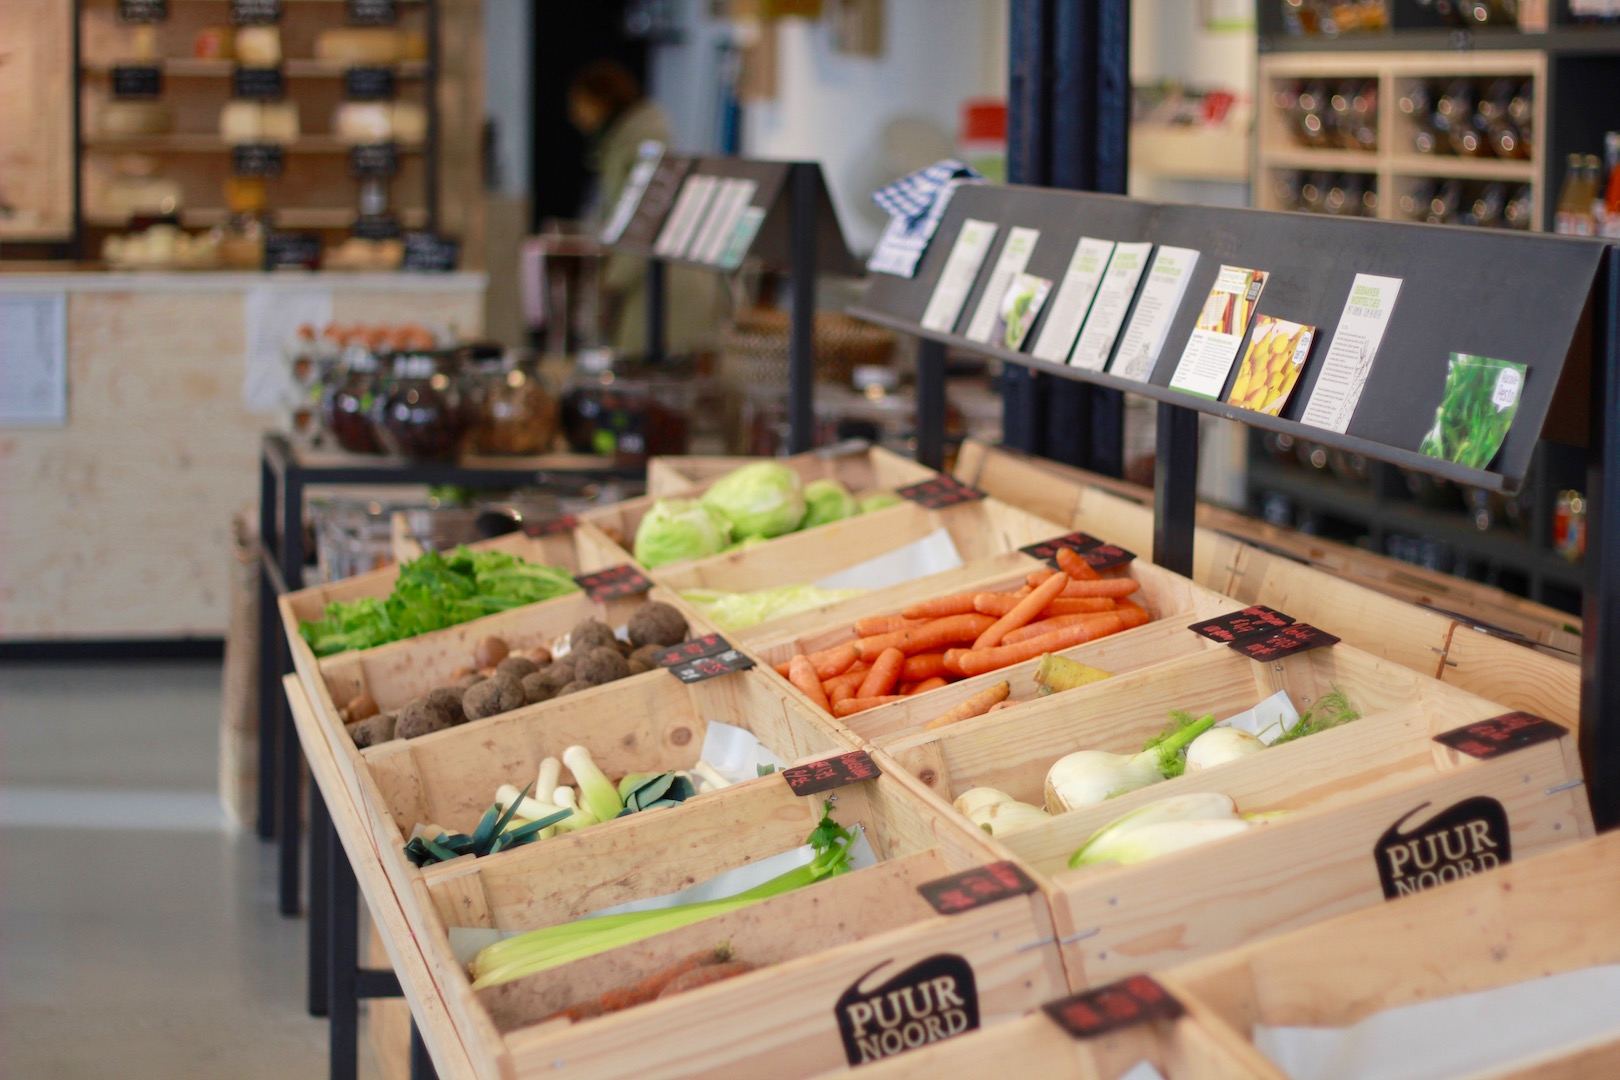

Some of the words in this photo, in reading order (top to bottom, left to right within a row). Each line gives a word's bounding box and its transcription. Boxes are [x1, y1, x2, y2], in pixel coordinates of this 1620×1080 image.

[1386, 819, 1498, 879] PUUR
[1394, 852, 1500, 897] NOORD
[846, 974, 965, 1038] PUUR
[856, 1008, 968, 1064] NOORD
